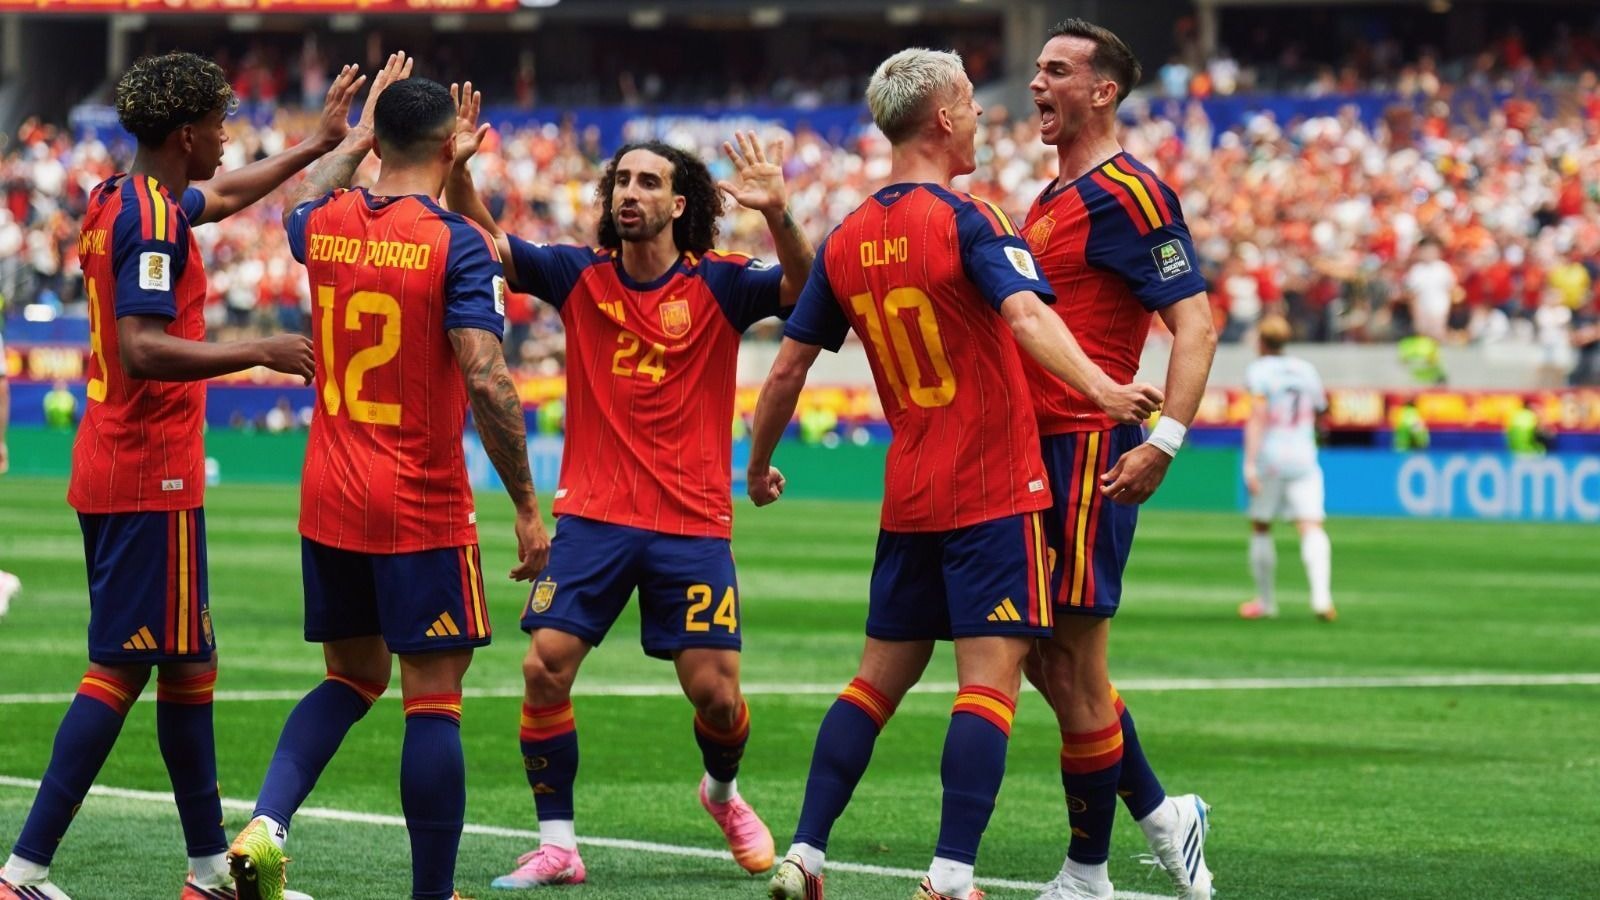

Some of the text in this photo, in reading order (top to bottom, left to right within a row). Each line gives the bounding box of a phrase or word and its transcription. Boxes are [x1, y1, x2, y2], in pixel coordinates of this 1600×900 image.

[309, 234, 431, 270] PEDRO PORRO
[859, 236, 908, 268] OLMO
[318, 286, 402, 426] 12
[612, 330, 666, 383] 24
[850, 287, 958, 412] 10
[685, 584, 737, 633] 24
